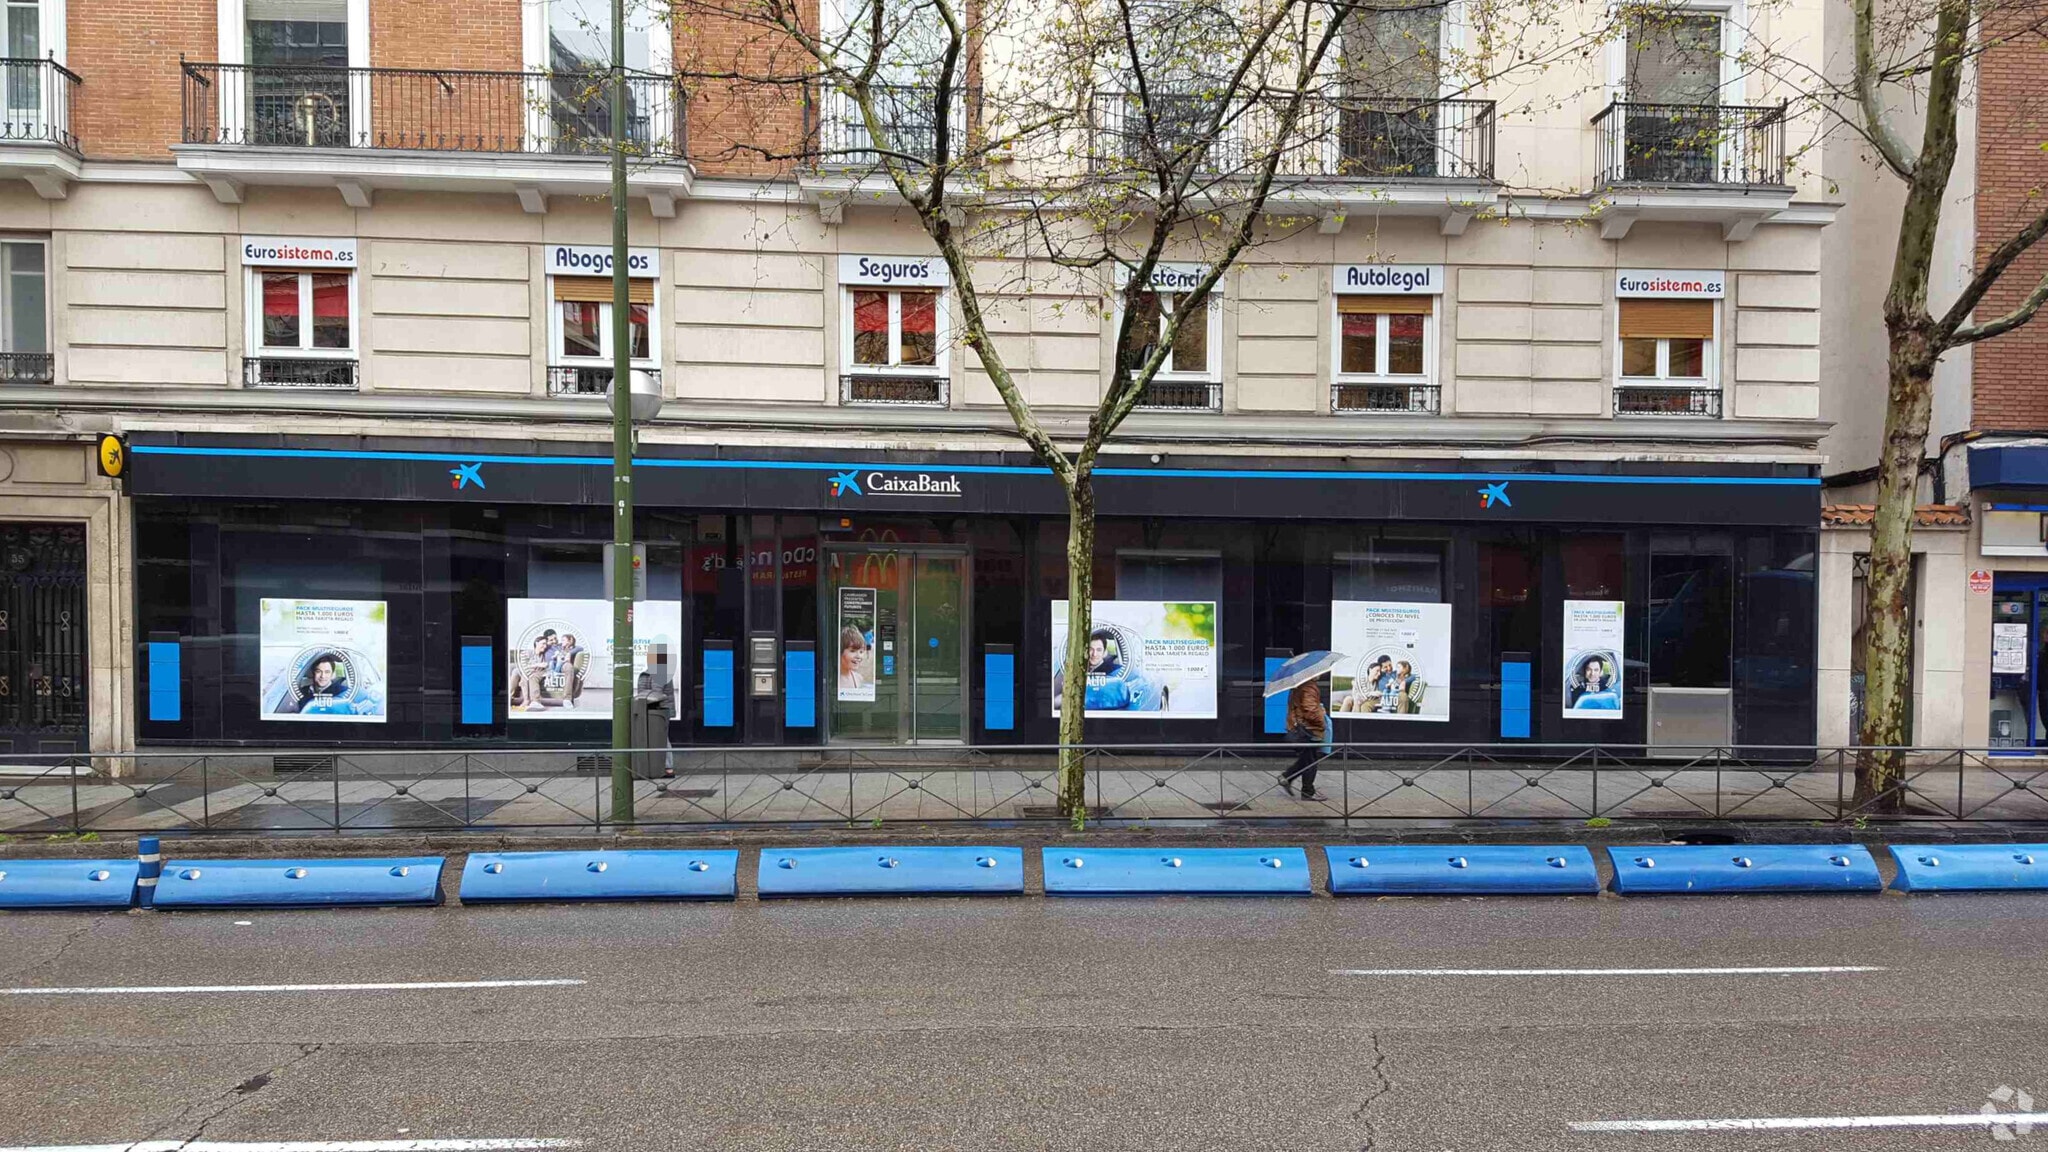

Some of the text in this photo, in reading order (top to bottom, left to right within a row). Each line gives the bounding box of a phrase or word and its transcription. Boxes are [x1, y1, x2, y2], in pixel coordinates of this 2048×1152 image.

[245, 244, 354, 261] Eurosistema.es
[556, 247, 649, 273] Abogaos
[859, 257, 929, 283] Seguros
[1347, 267, 1430, 291] Autolegal
[1619, 277, 1722, 292] Eurosistema.es
[867, 472, 962, 493] CaixaBank
[544, 676, 566, 687] ALTO
[1086, 675, 1106, 687] ALTO
[1586, 684, 1600, 692] ALTO
[314, 697, 333, 707] ALTO
[1380, 696, 1399, 707] ALTO
